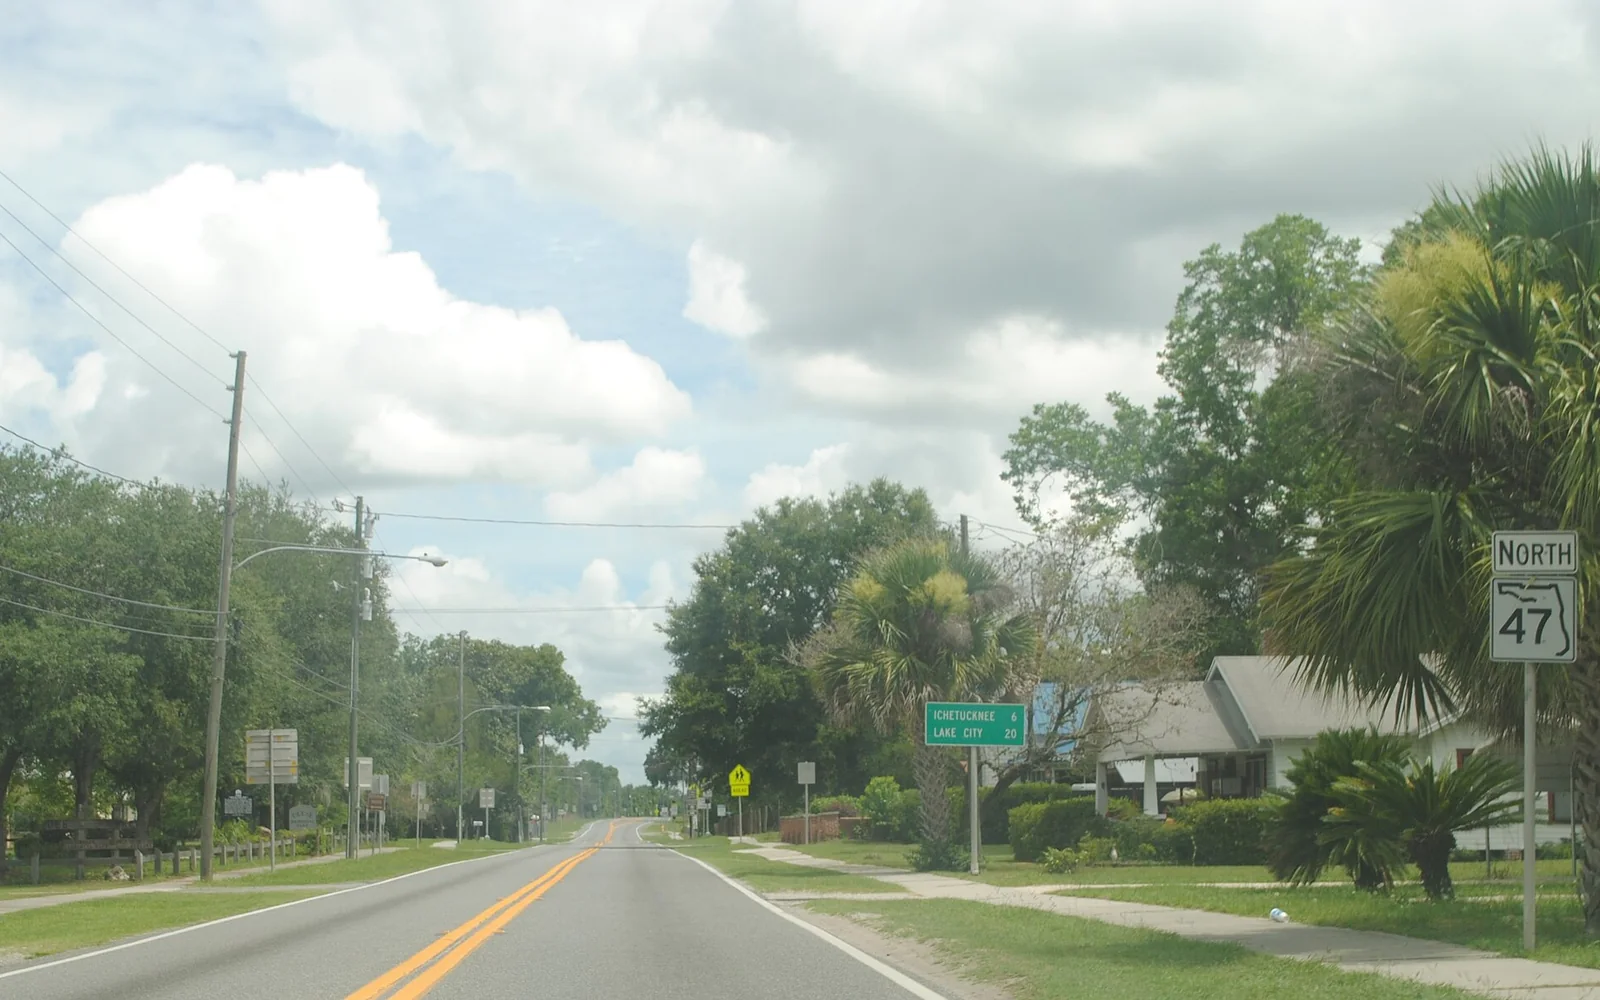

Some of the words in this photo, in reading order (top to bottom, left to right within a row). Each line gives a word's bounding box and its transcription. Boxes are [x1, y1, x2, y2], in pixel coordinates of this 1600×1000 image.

[1499, 540, 1571, 565] NORTH
[1498, 608, 1553, 645] 47
[933, 710, 995, 721] ICHETUCKNEE
[1011, 712, 1017, 722] 6
[933, 727, 956, 737] LAKE
[963, 728, 983, 738] CITY
[1004, 729, 1017, 739] 20
